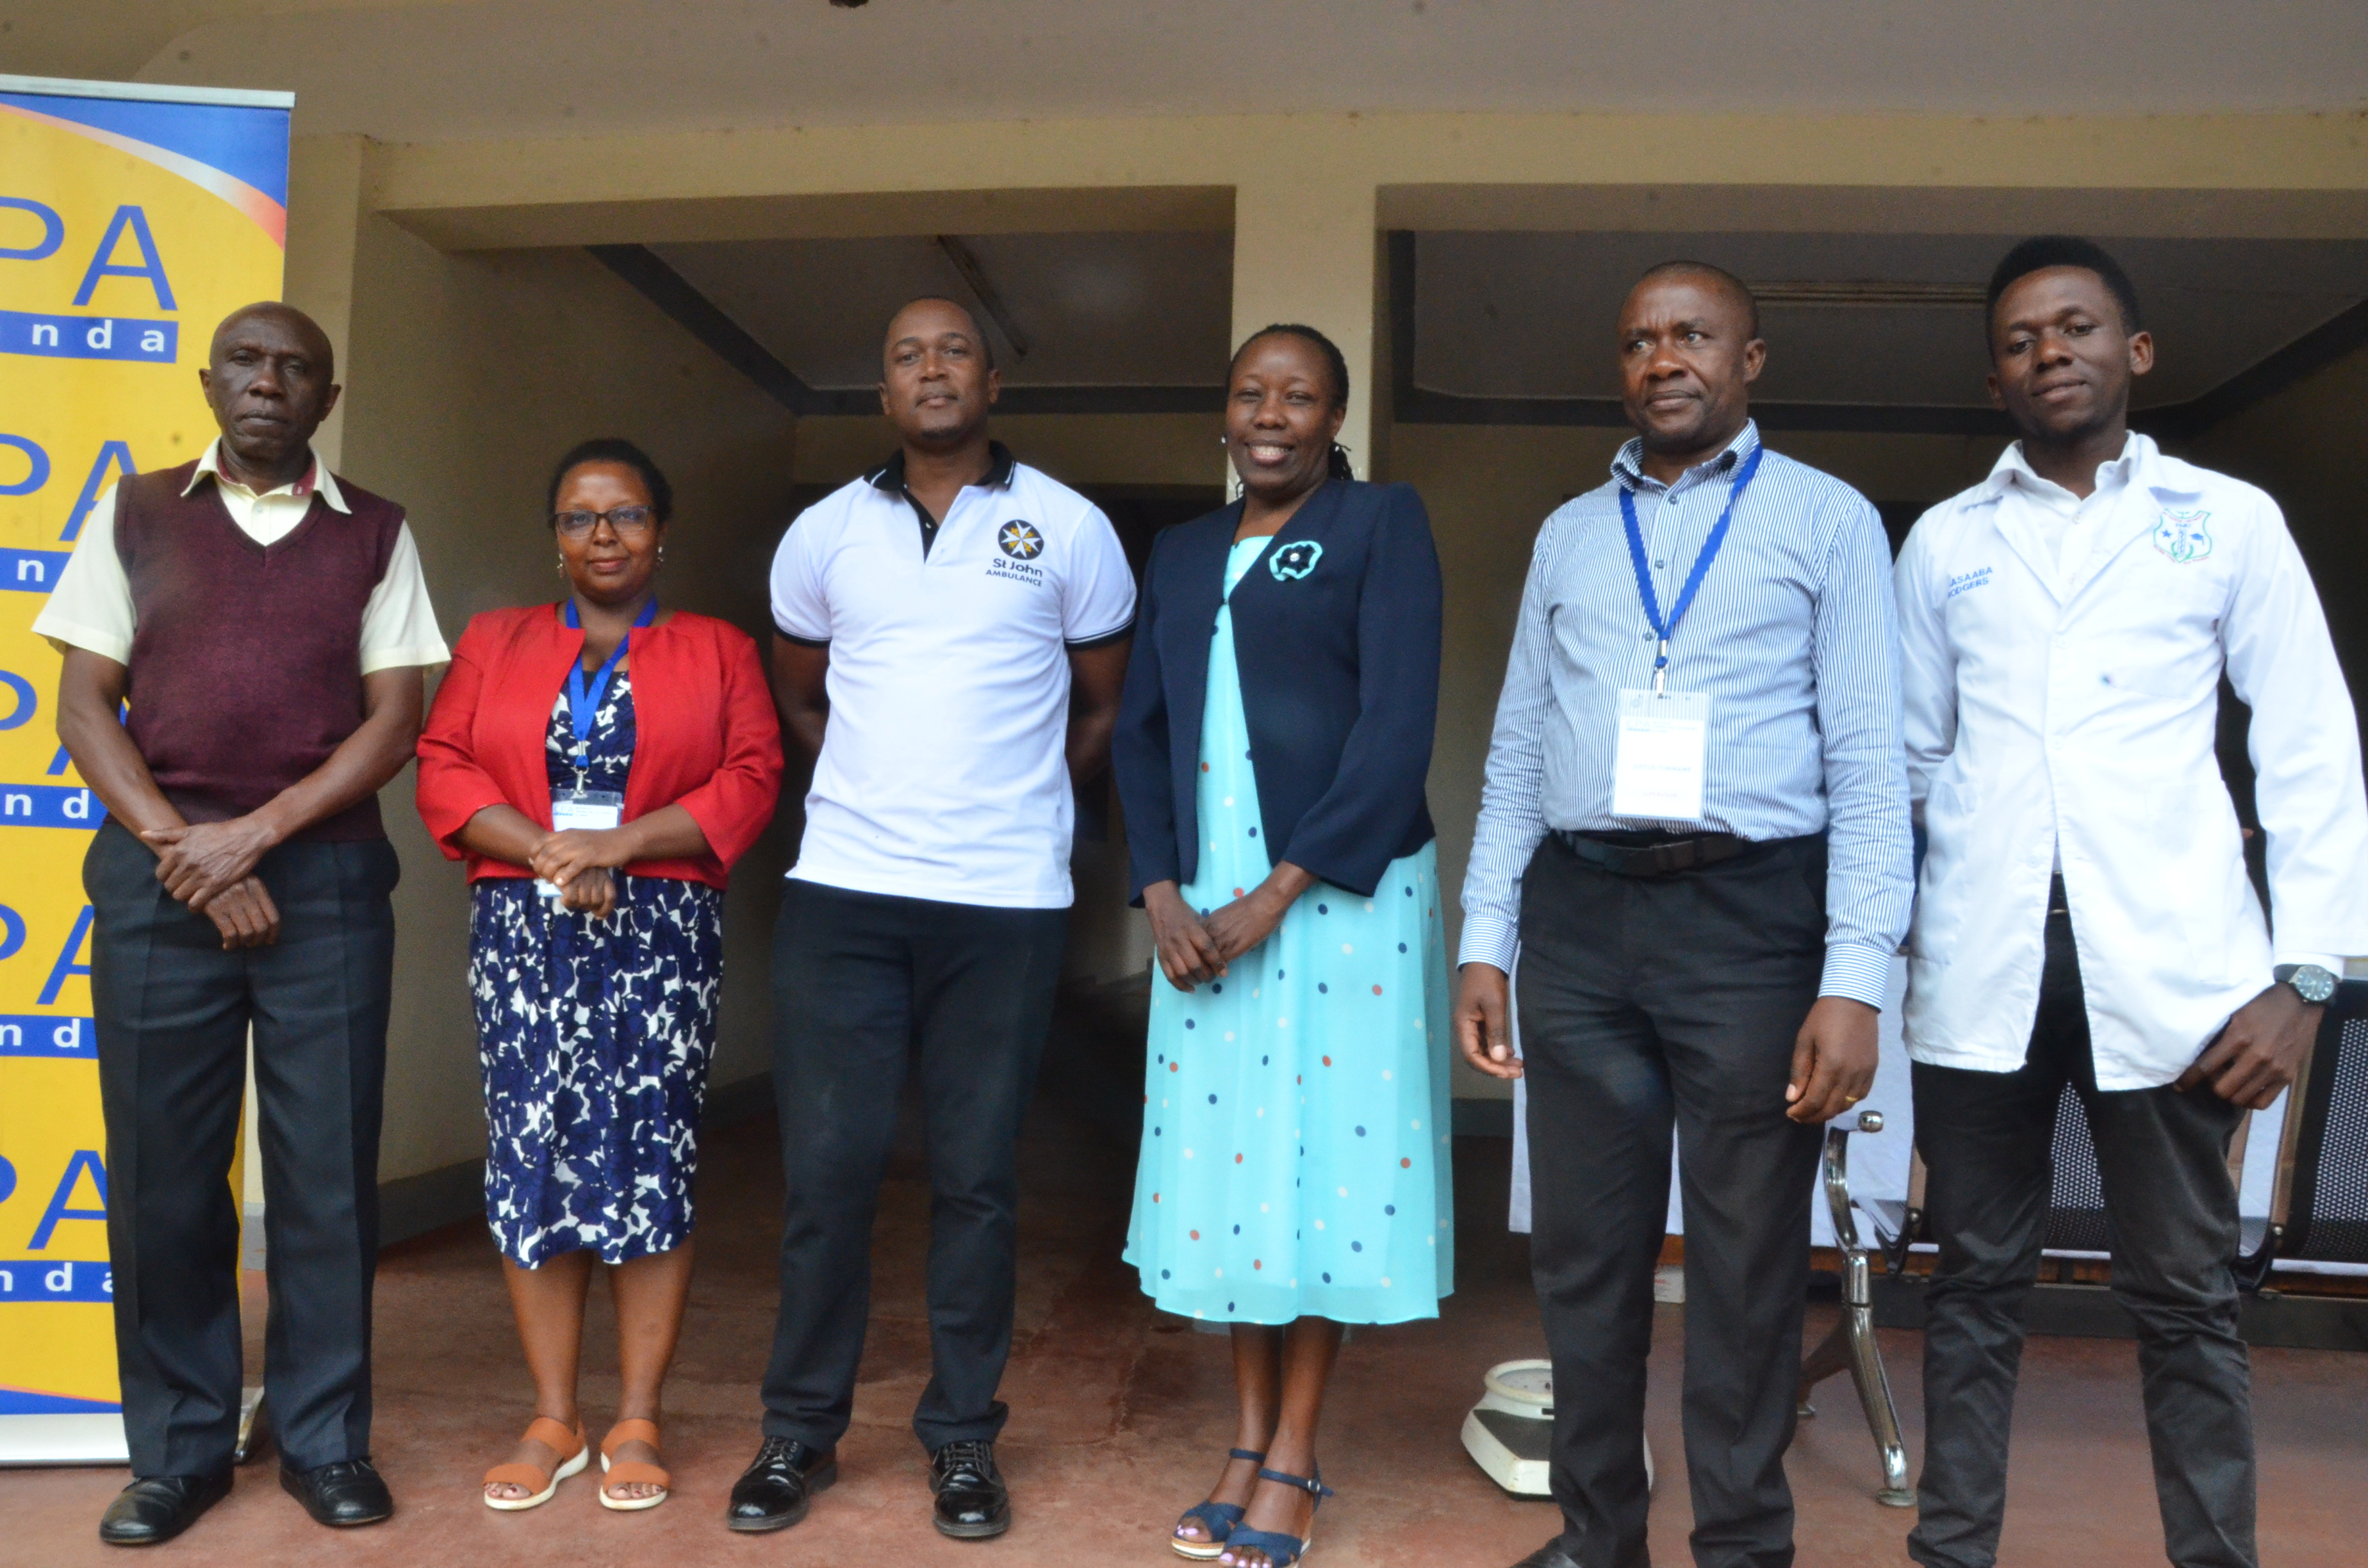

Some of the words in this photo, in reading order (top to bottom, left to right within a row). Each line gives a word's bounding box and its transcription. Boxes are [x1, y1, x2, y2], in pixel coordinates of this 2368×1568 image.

[32, 319, 165, 352] nda
[993, 558, 1006, 568] St
[1010, 562, 1042, 577] John
[986, 569, 1042, 587] AMBULANCE
